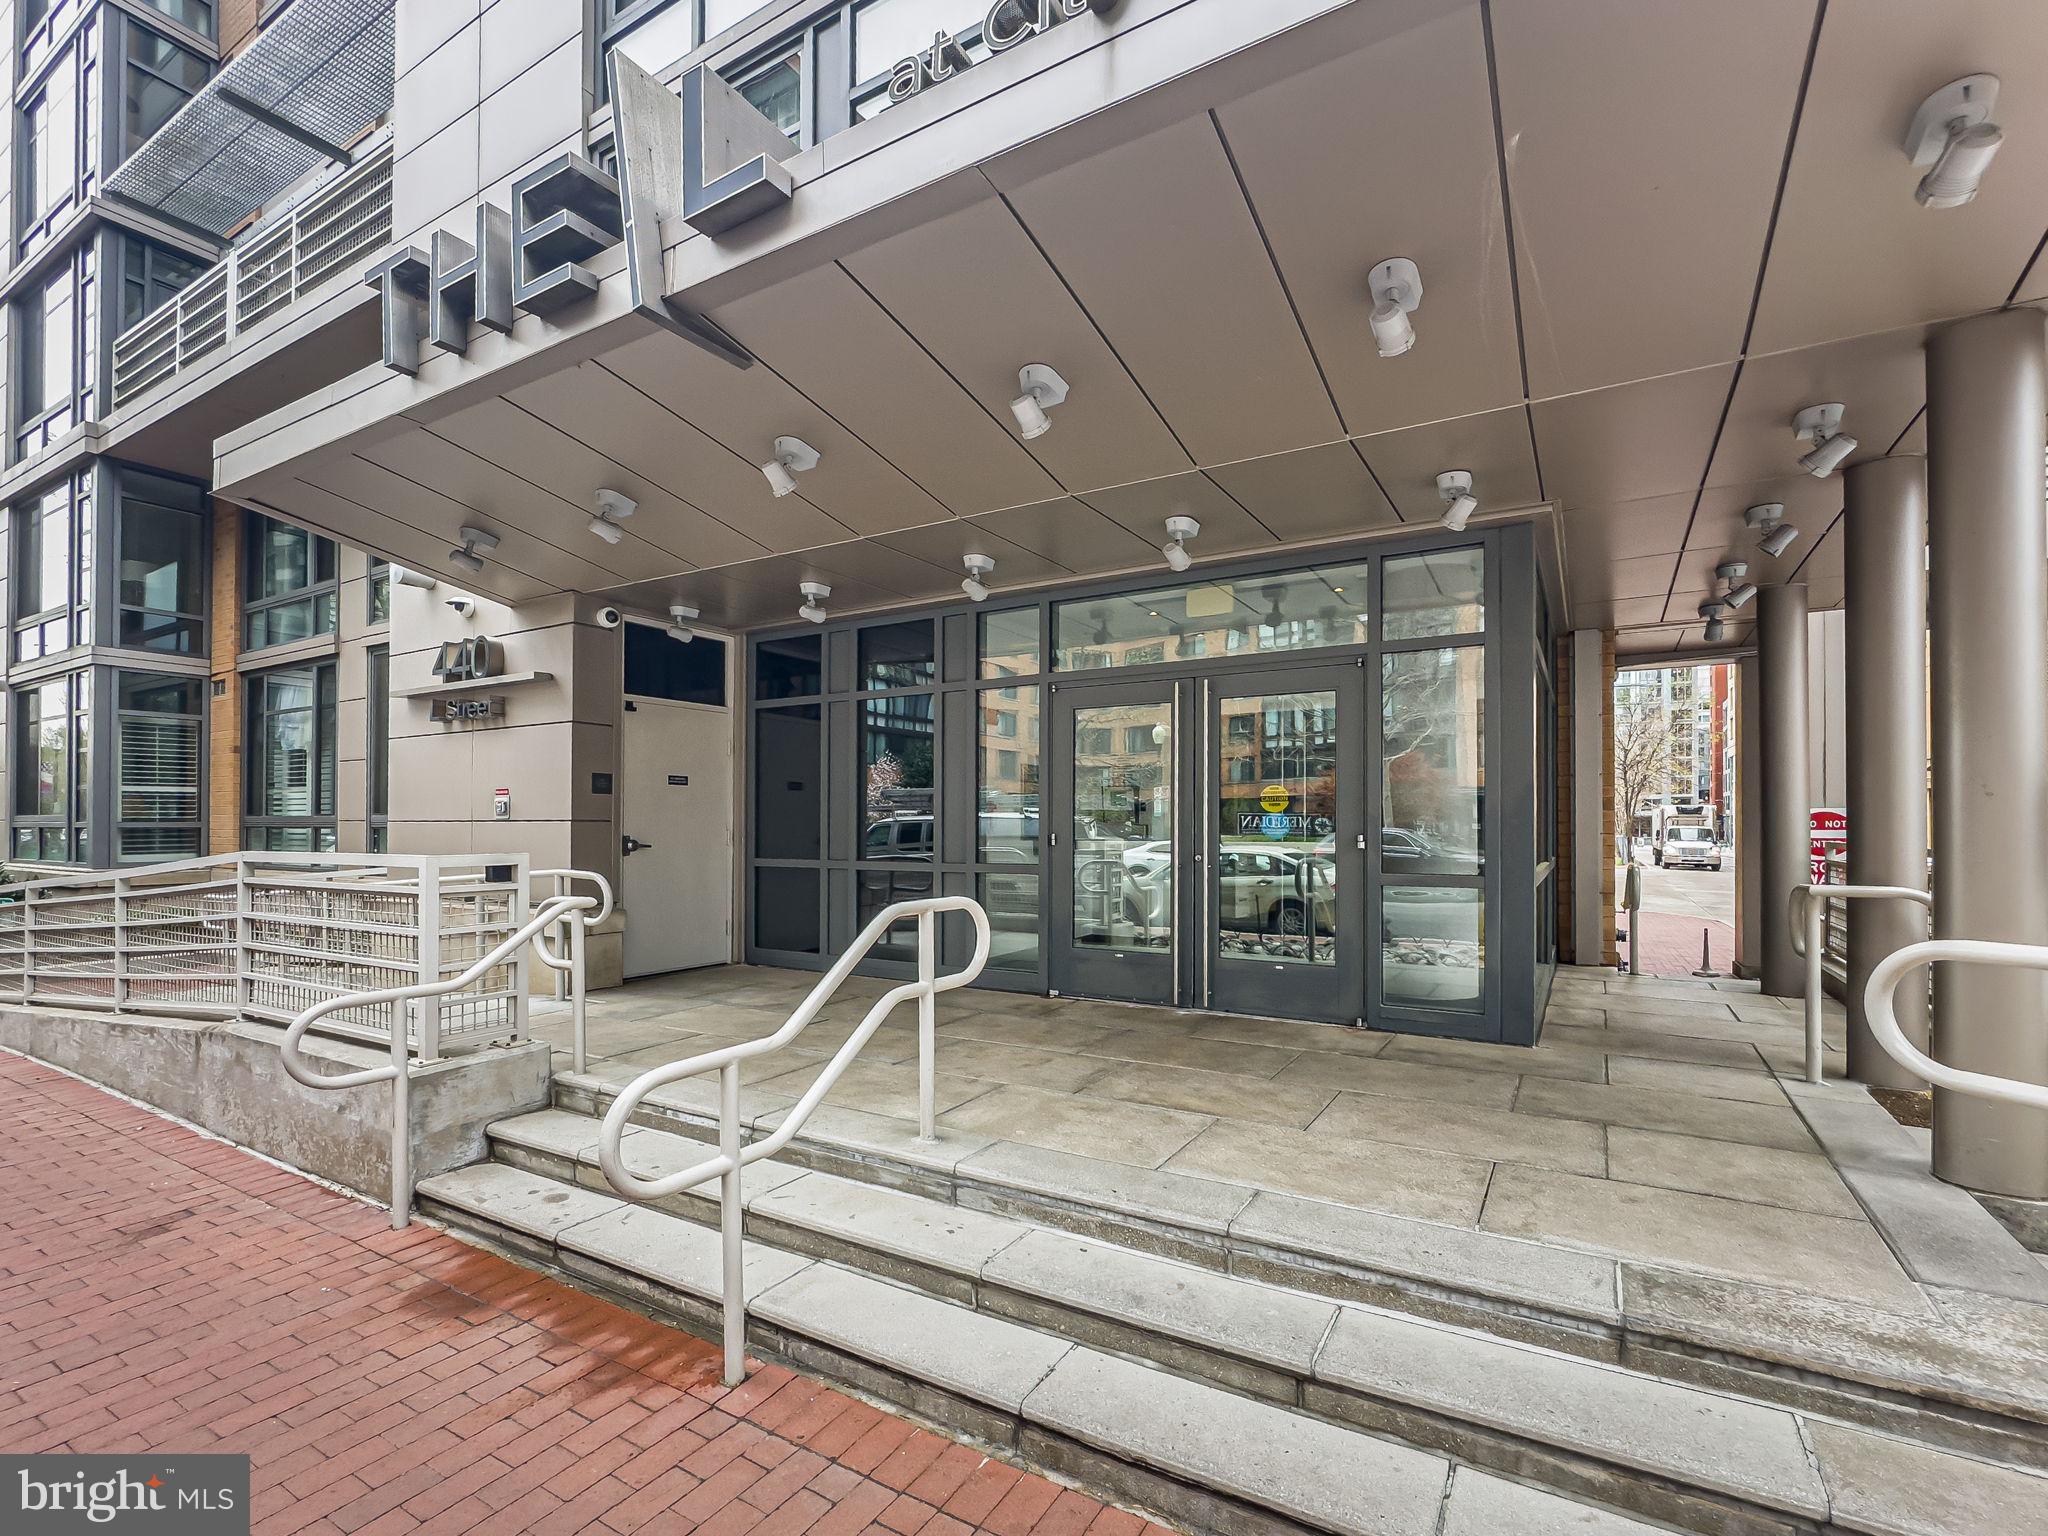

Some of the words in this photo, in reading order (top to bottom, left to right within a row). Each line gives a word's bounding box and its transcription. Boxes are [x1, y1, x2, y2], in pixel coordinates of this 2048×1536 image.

[888, 28, 954, 102] at
[364, 151, 598, 377] THE
[682, 62, 782, 234] L
[432, 635, 491, 684] 440
[446, 699, 493, 720] Street
[1825, 820, 1847, 828] NOT
